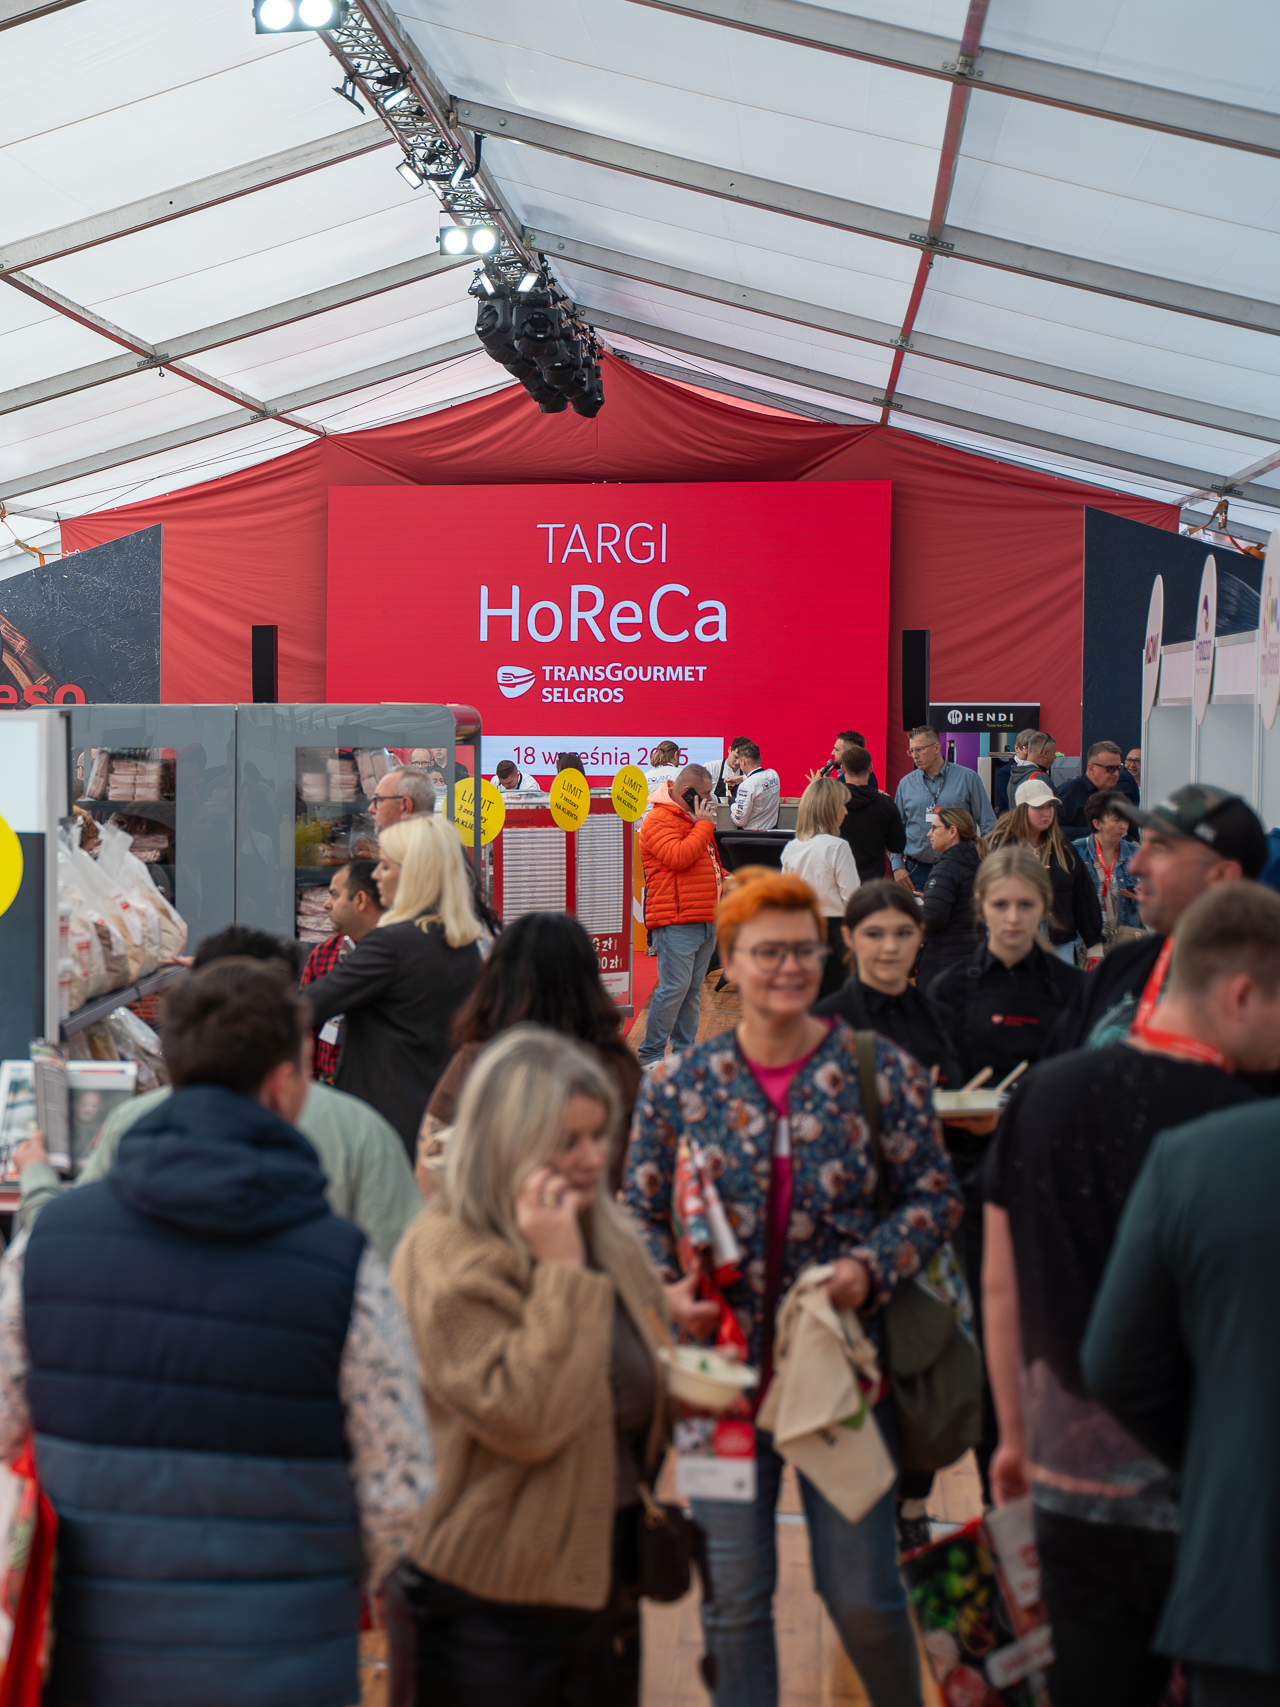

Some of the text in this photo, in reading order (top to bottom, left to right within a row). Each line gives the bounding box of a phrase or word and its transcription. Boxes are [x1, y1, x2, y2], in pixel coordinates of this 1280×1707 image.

[536, 522, 667, 564] TARGI
[479, 583, 728, 643] HoReCa
[541, 662, 708, 682] TRANSGOURMET
[541, 687, 624, 703] SELGROS
[964, 713, 1014, 721] HENDI
[513, 746, 536, 765] 18
[542, 746, 630, 765] weśnia
[562, 779, 583, 799] LIMIT
[623, 774, 643, 793] LIMIT
[461, 790, 494, 811] LIIT
[609, 955, 619, 968] zł
